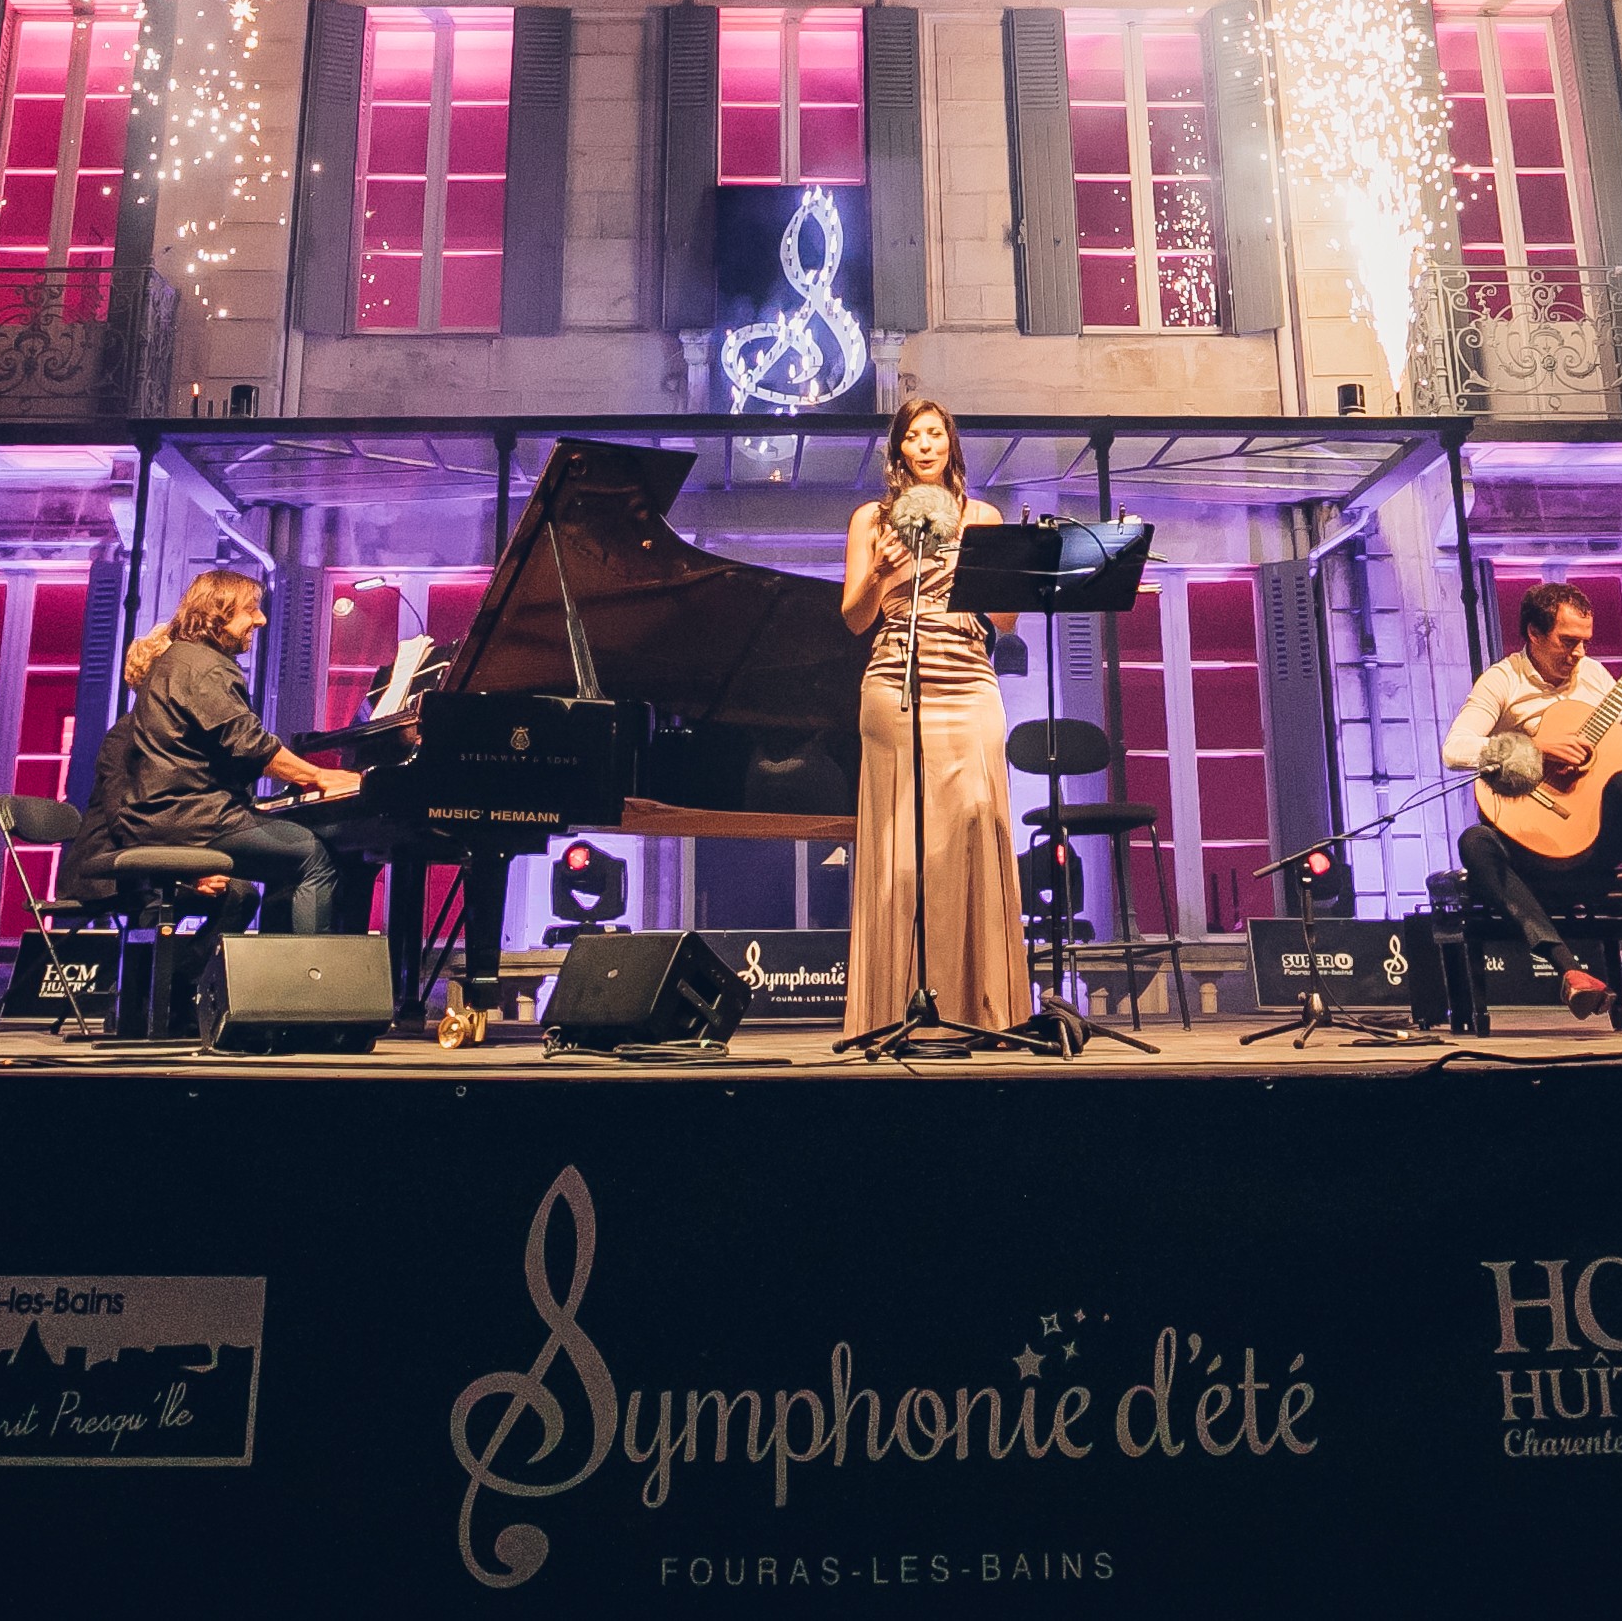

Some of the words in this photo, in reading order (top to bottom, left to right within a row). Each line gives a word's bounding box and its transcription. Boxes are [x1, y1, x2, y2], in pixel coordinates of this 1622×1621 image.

[460, 753, 527, 762] STEINWAY
[547, 756, 578, 765] SONS
[490, 810, 560, 824] HEMANN
[43, 964, 99, 981] HCM
[737, 940, 846, 992] Symphonie
[450, 1163, 1095, 1589] Symphonie
[1115, 1326, 1319, 1459] d'été
[660, 1551, 1116, 1586] FOURAS-LES-BAINS
